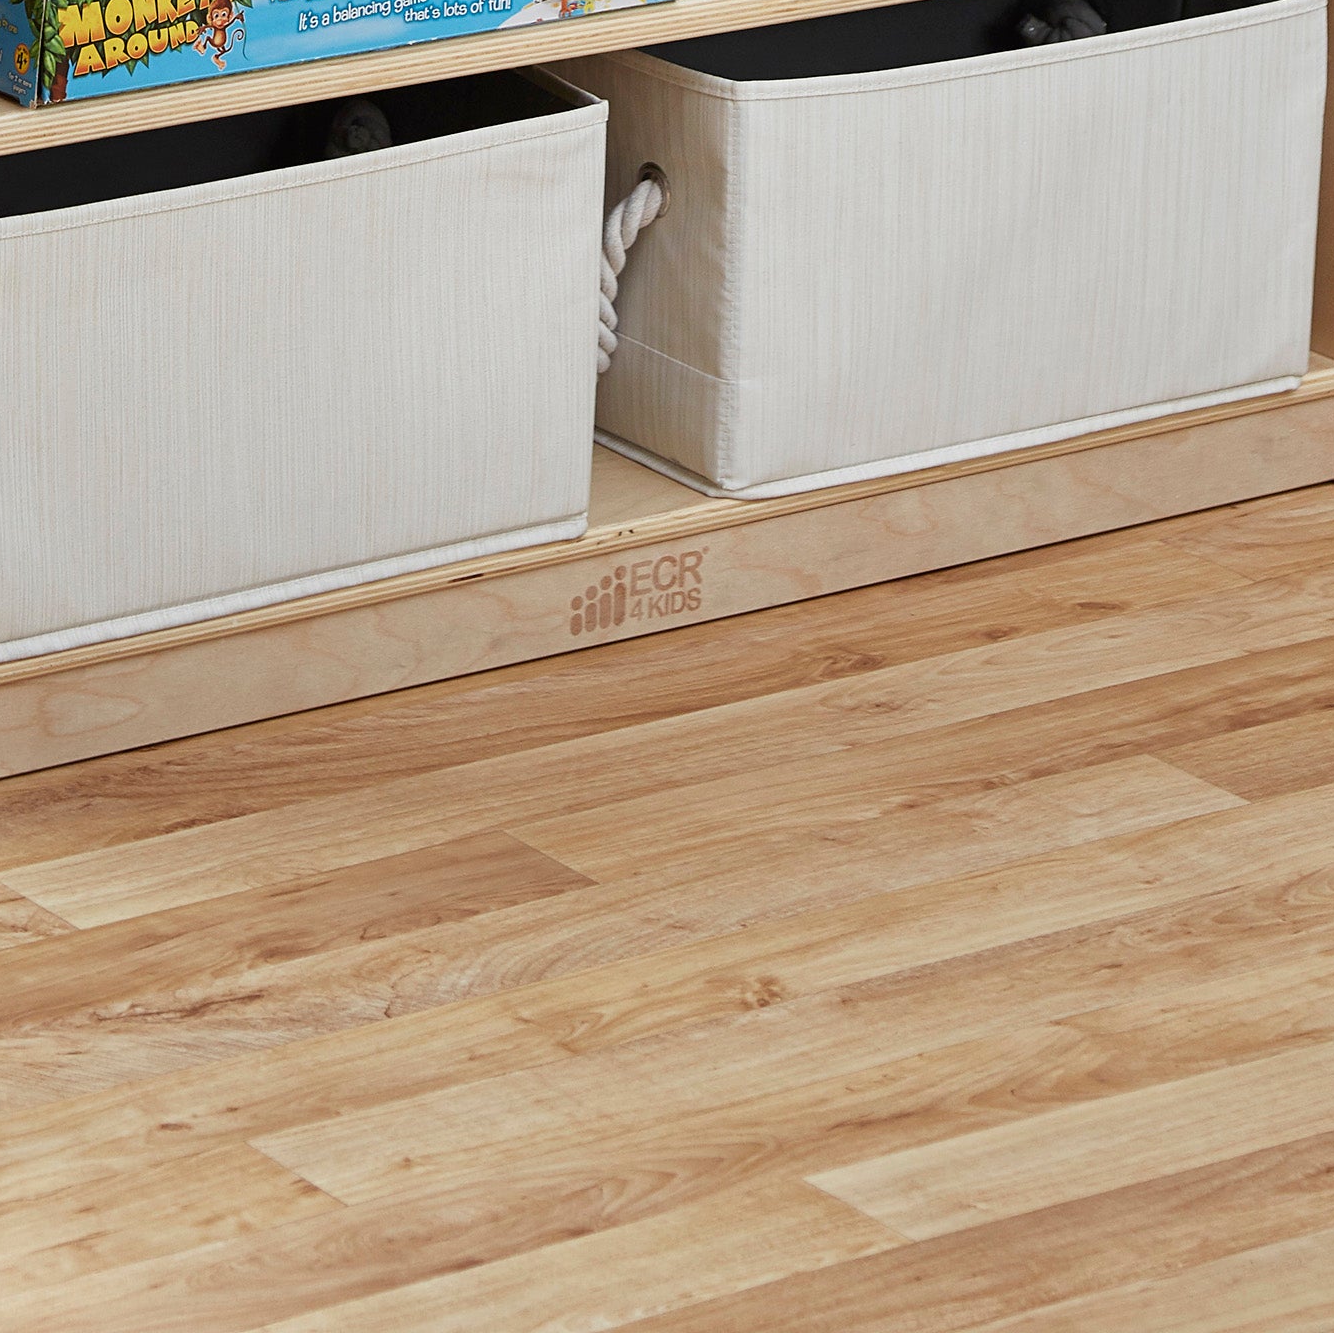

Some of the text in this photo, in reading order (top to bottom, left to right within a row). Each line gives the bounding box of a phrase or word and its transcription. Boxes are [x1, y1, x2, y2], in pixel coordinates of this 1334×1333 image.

[298, 11, 319, 32] It's
[321, 14, 330, 26] a
[404, 5, 441, 23] that's
[443, 1, 468, 18] lots
[17, 52, 28, 70] 4+
[74, 20, 201, 77] AROUND
[629, 549, 704, 597] ECR
[629, 587, 703, 622] 4 KIDS
